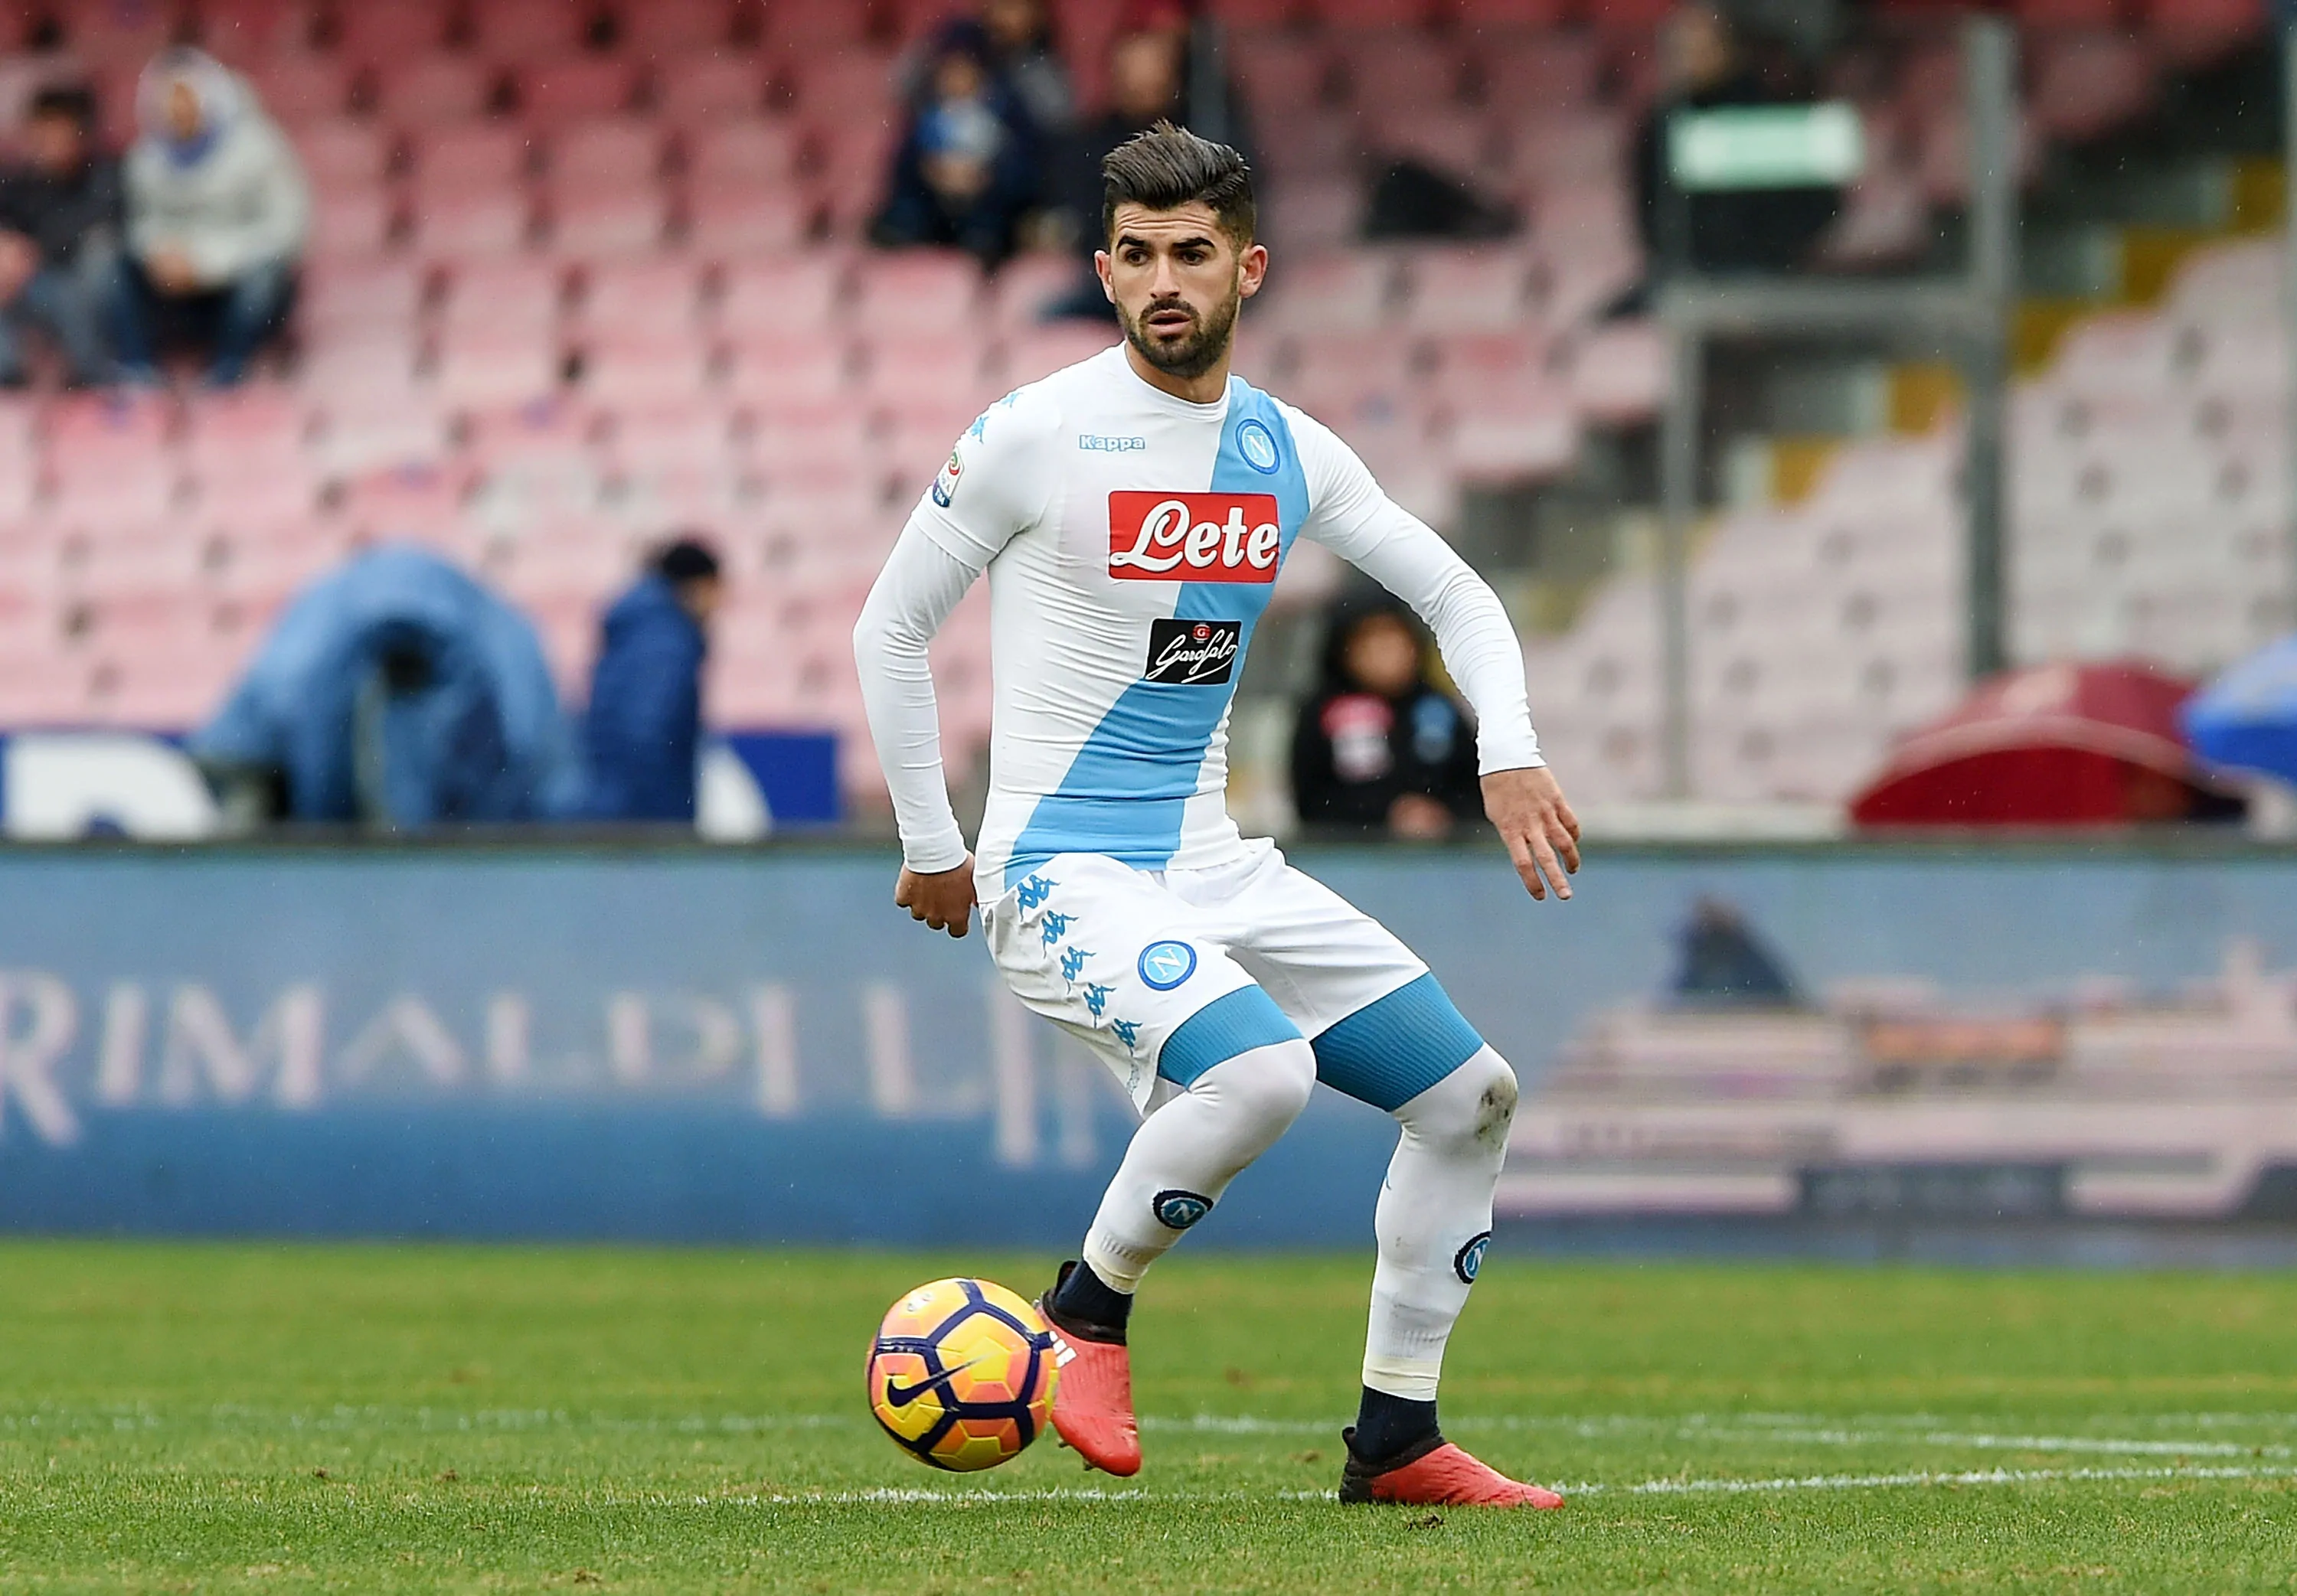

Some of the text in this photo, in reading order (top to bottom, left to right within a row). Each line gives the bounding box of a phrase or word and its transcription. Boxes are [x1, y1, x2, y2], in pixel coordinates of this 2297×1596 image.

[1079, 434, 1145, 452] Kappa
[1109, 499, 1280, 573] Lete
[1145, 628, 1239, 684] Garofalo
[1149, 947, 1181, 978] N
